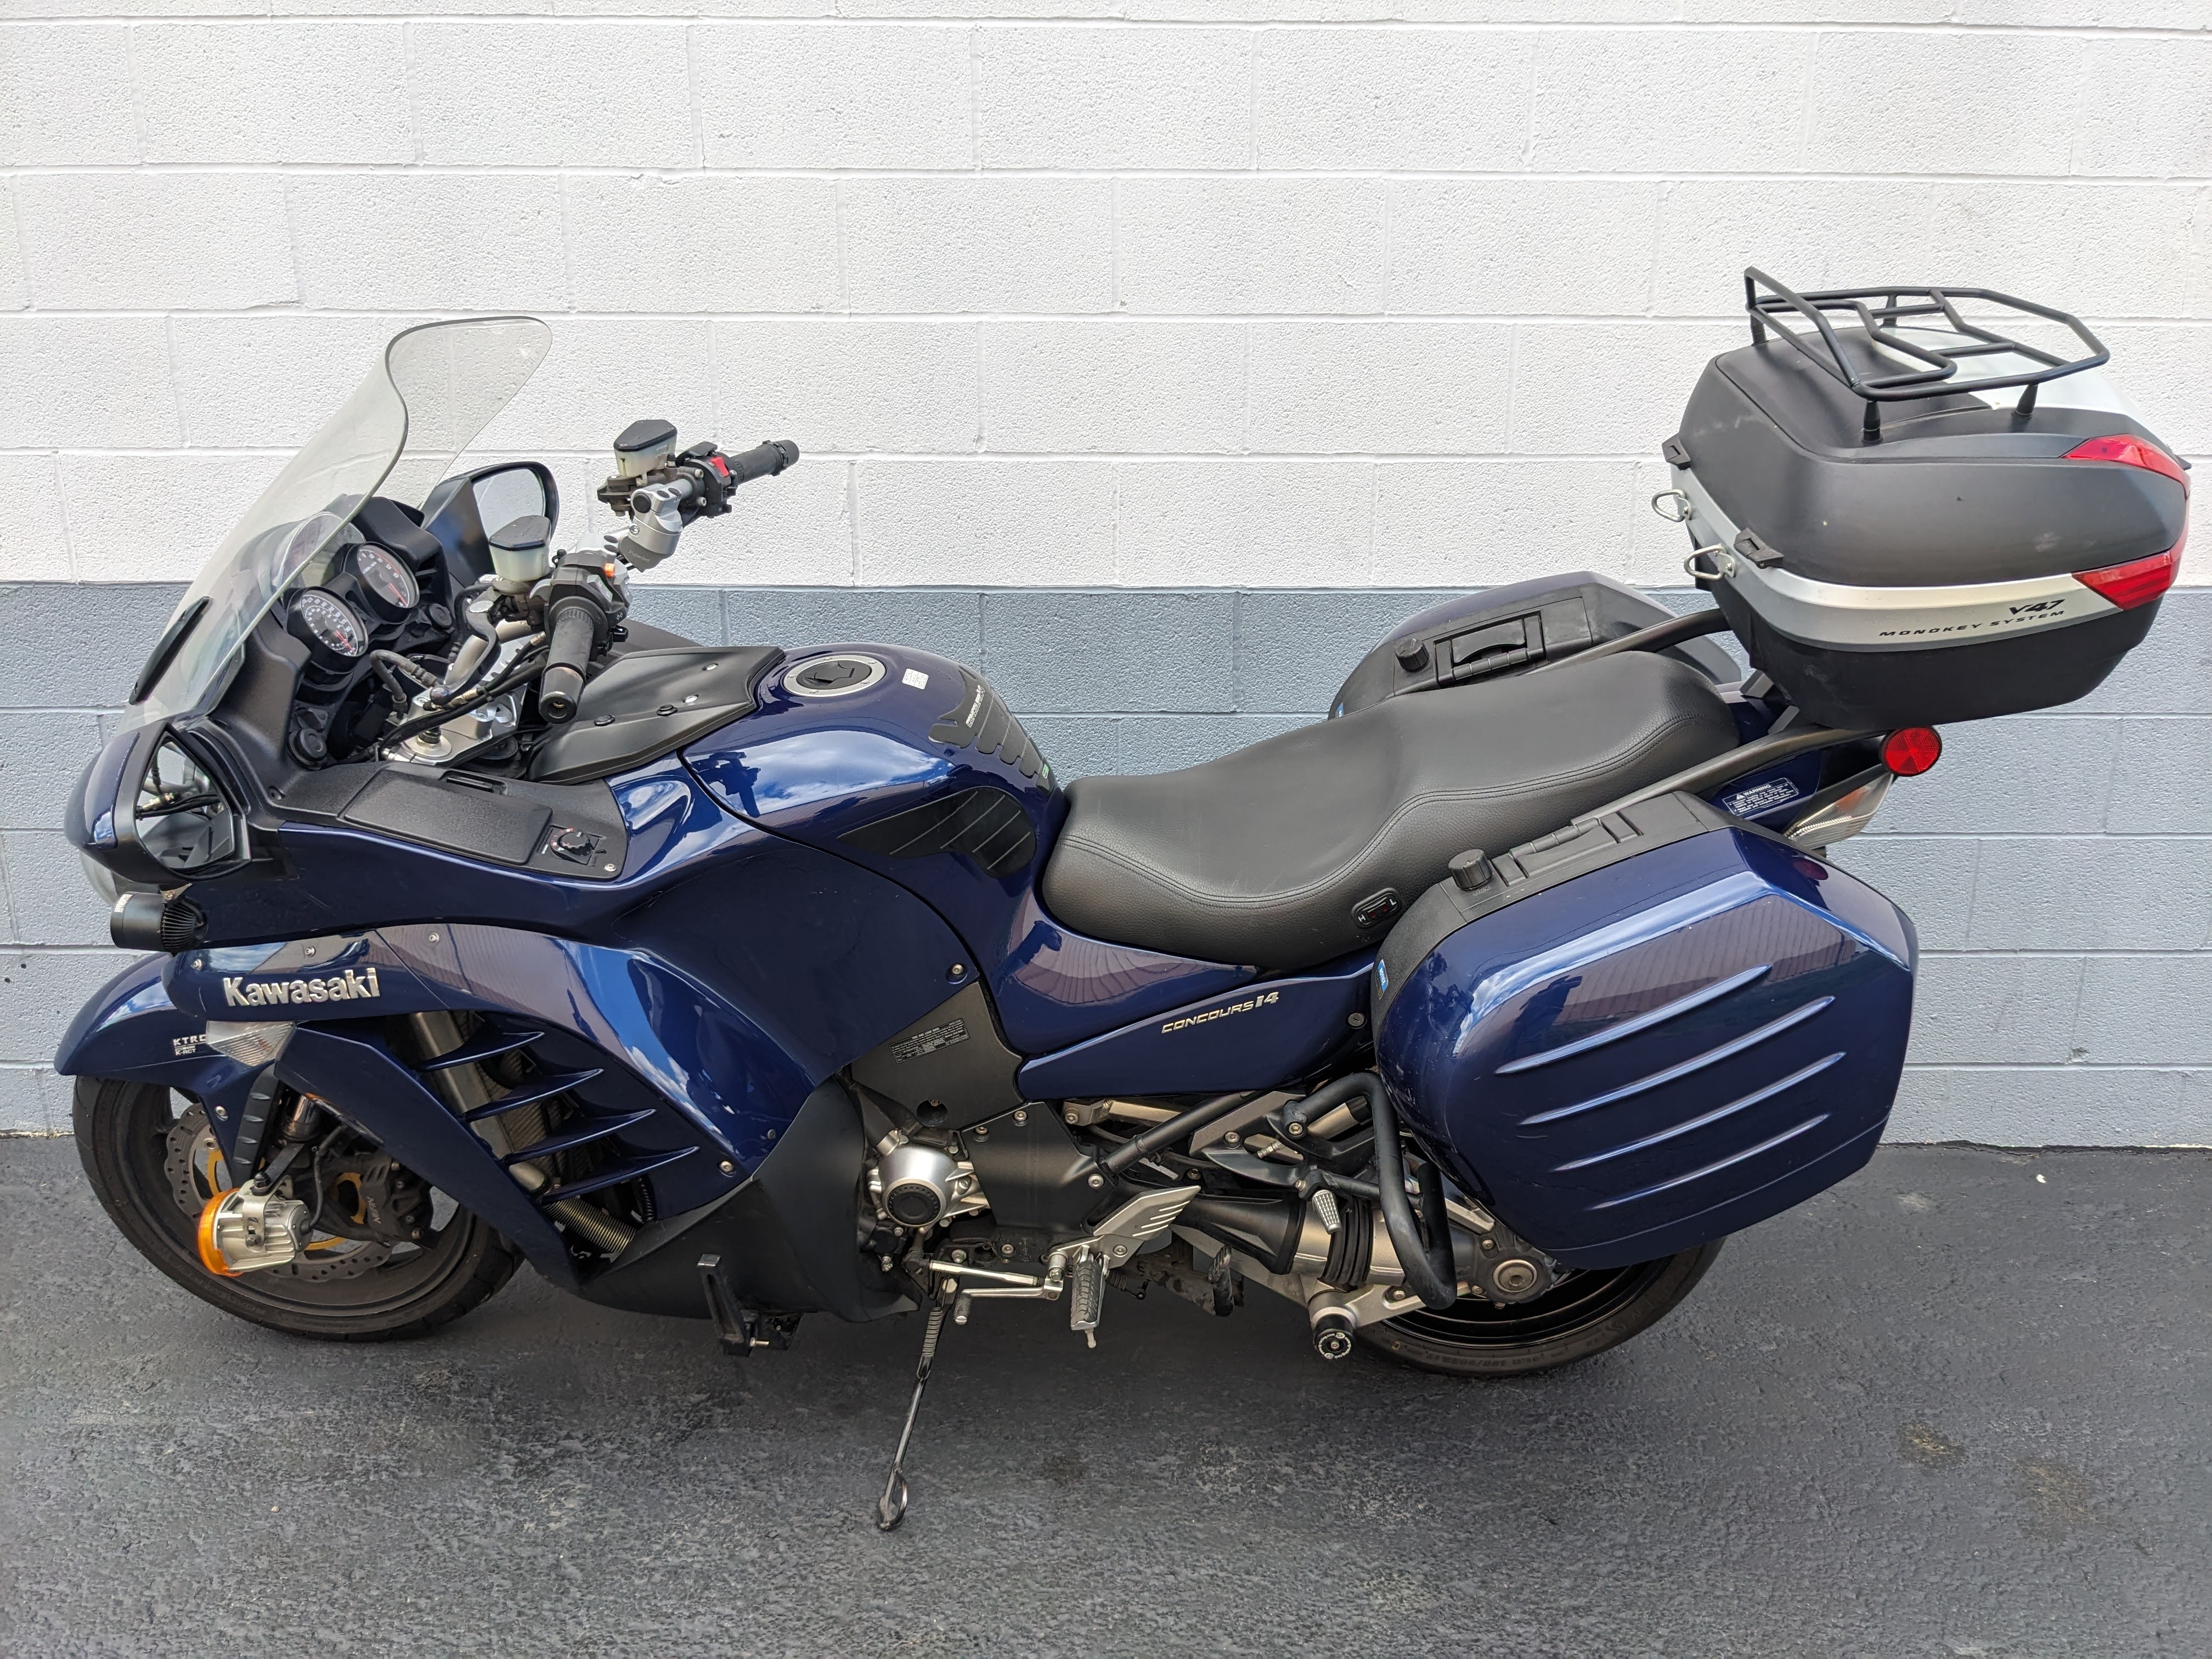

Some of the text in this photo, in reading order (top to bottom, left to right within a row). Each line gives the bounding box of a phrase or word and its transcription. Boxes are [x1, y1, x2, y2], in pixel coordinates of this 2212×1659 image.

[2009, 599, 2065, 615] V47
[1879, 611, 2064, 636] MONOKEY SYSTEM
[1743, 784, 1772, 796] WARNING
[223, 967, 380, 1007] Kawasaki
[173, 1034, 206, 1046] KTRC
